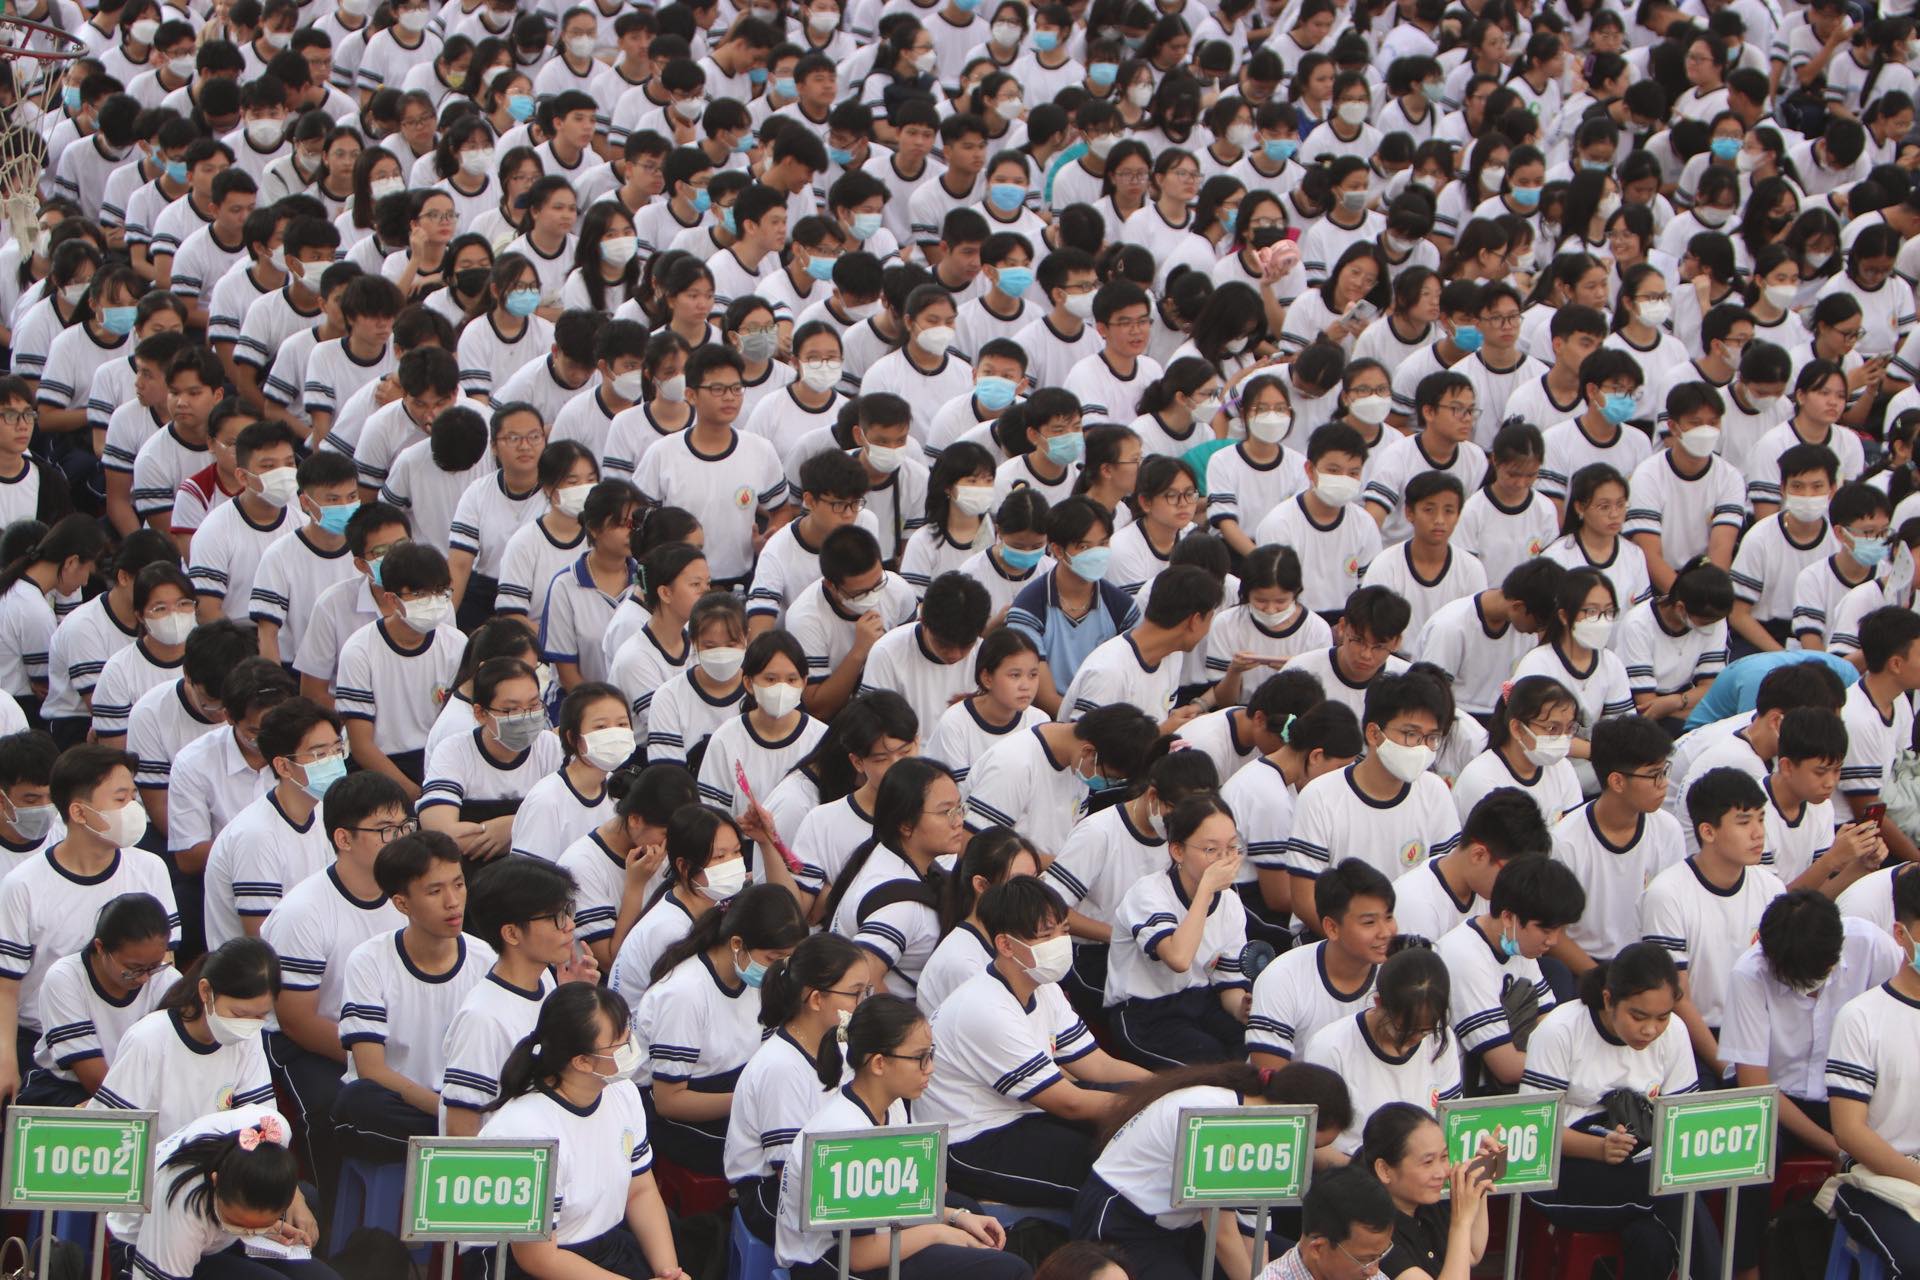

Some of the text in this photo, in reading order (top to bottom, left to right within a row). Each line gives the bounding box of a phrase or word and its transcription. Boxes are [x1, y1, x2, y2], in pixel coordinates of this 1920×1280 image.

[1680, 1124, 1759, 1158] 10C07
[33, 1145, 131, 1175] 10C02
[1203, 1143, 1291, 1172] 10C05
[435, 1175, 532, 1205] 10C03
[830, 1157, 919, 1199] 10C04
